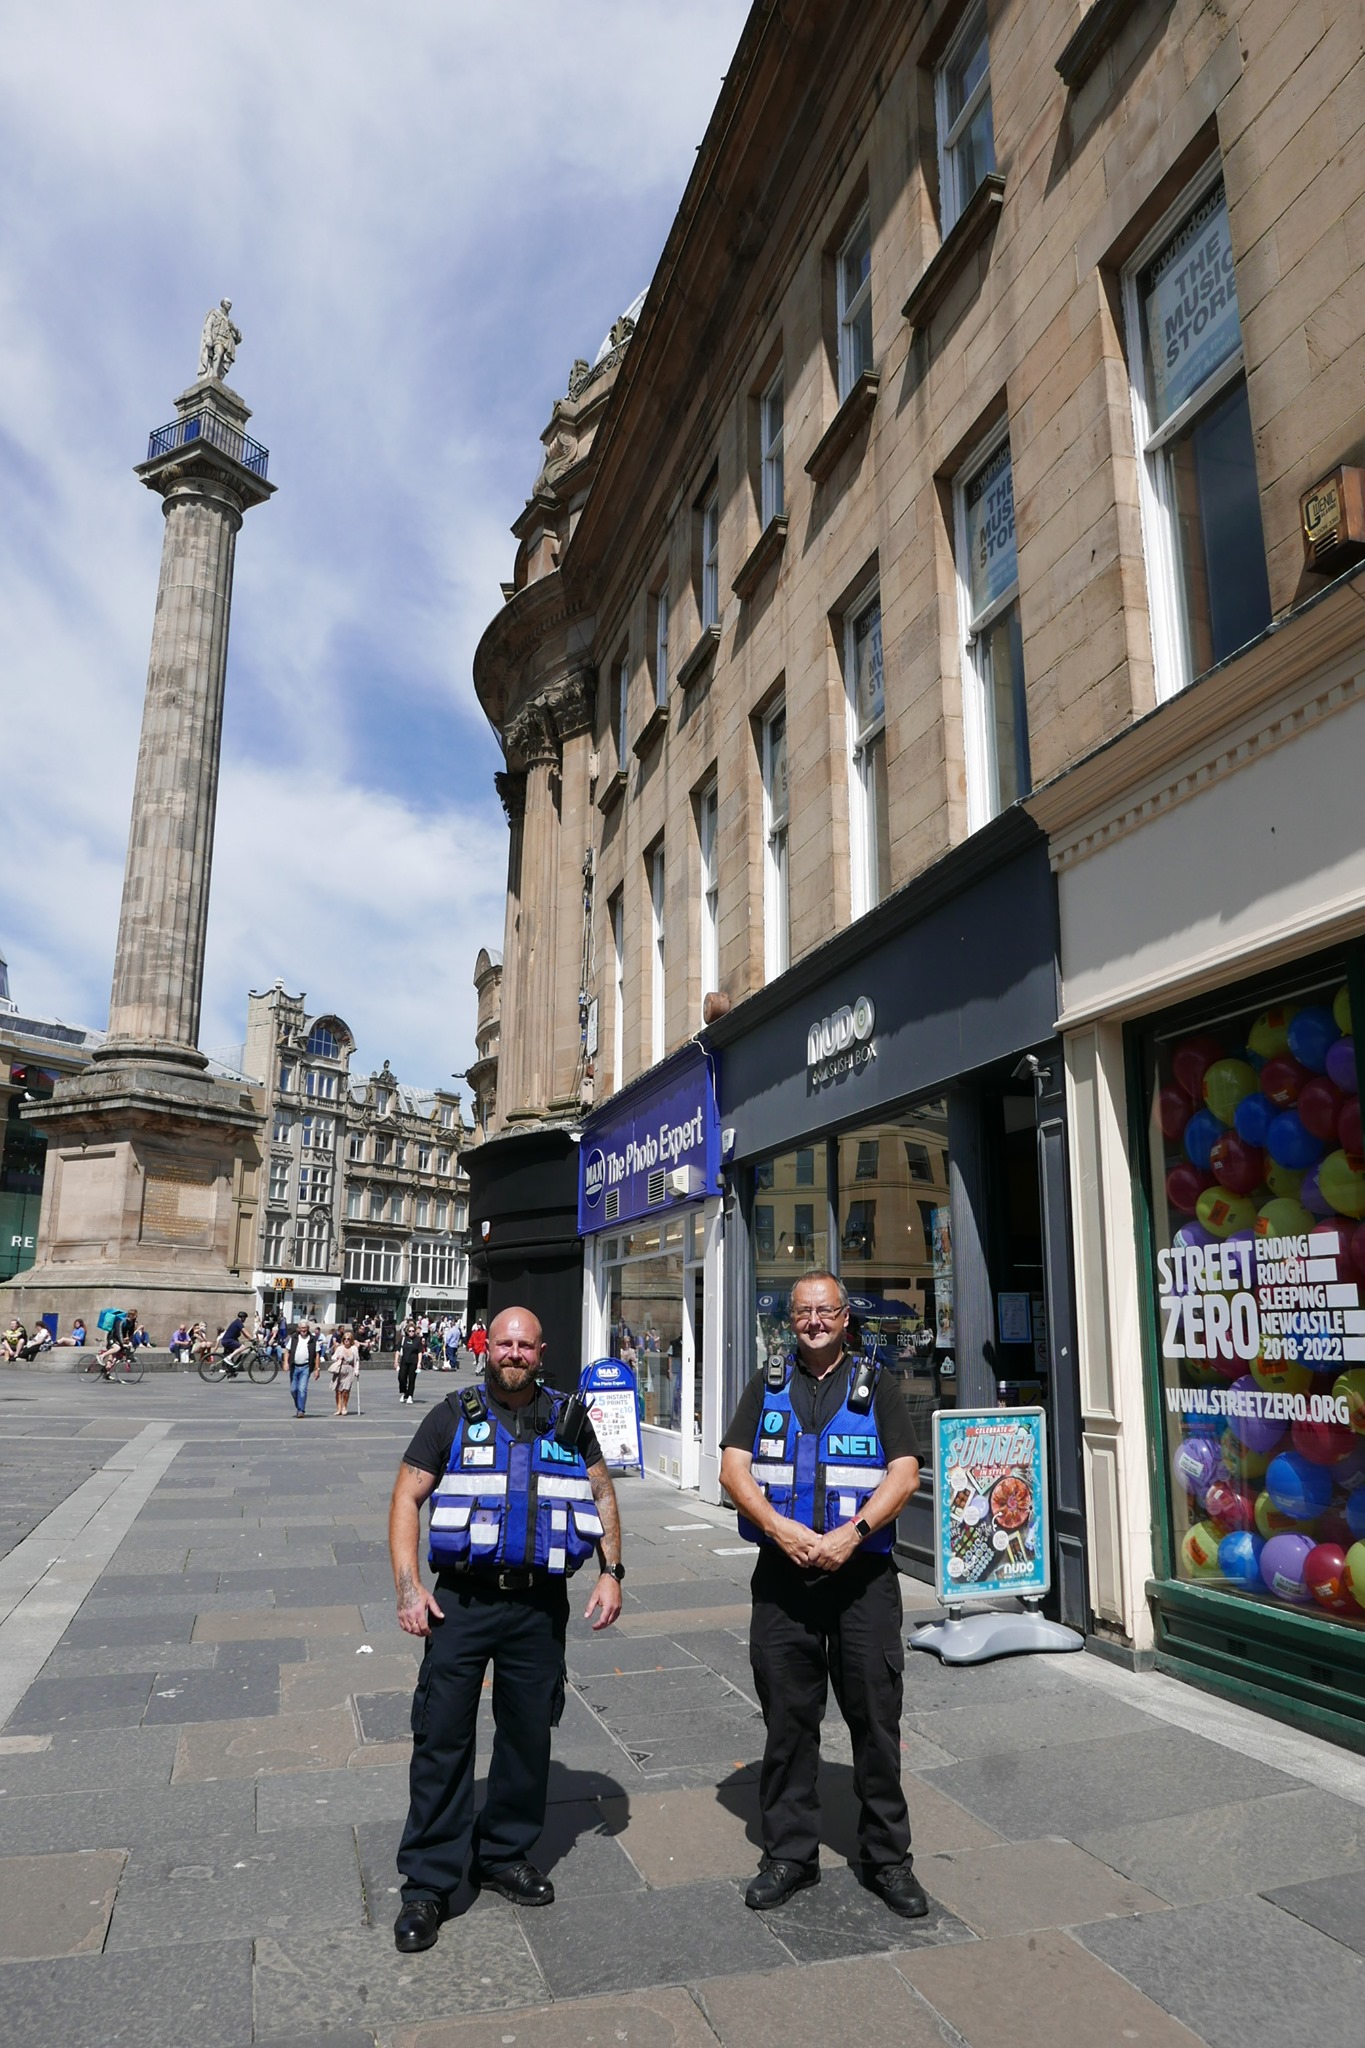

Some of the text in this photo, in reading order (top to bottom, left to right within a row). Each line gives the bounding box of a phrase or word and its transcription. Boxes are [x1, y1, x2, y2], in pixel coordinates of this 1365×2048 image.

[1174, 229, 1221, 297] THE
[1165, 248, 1235, 343] MUSIC
[1167, 276, 1238, 368] STORE
[807, 995, 875, 1066] NUDO
[855, 1040, 878, 1066] BOX
[607, 1106, 704, 1186] The Photo Expert
[586, 1160, 603, 1187] MAX
[1254, 1234, 1308, 1261] ENDING
[1157, 1240, 1253, 1294] STREET
[1257, 1260, 1307, 1285] ROUGH
[1258, 1285, 1327, 1310] SLEEPING
[1160, 1291, 1260, 1360] ZERO
[1261, 1310, 1343, 1335] NEWCASTLE
[1263, 1337, 1343, 1361] 2018-2022
[620, 1406, 633, 1414] £10
[1165, 1387, 1350, 1425] WWW.STREETZERO.ORG
[975, 1426, 1008, 1434] CELEBRATE
[829, 1434, 877, 1456] NE1
[945, 1433, 1035, 1468] SUMMER
[988, 1468, 1006, 1476] STYLE
[1004, 1561, 1034, 1574] NUDO
